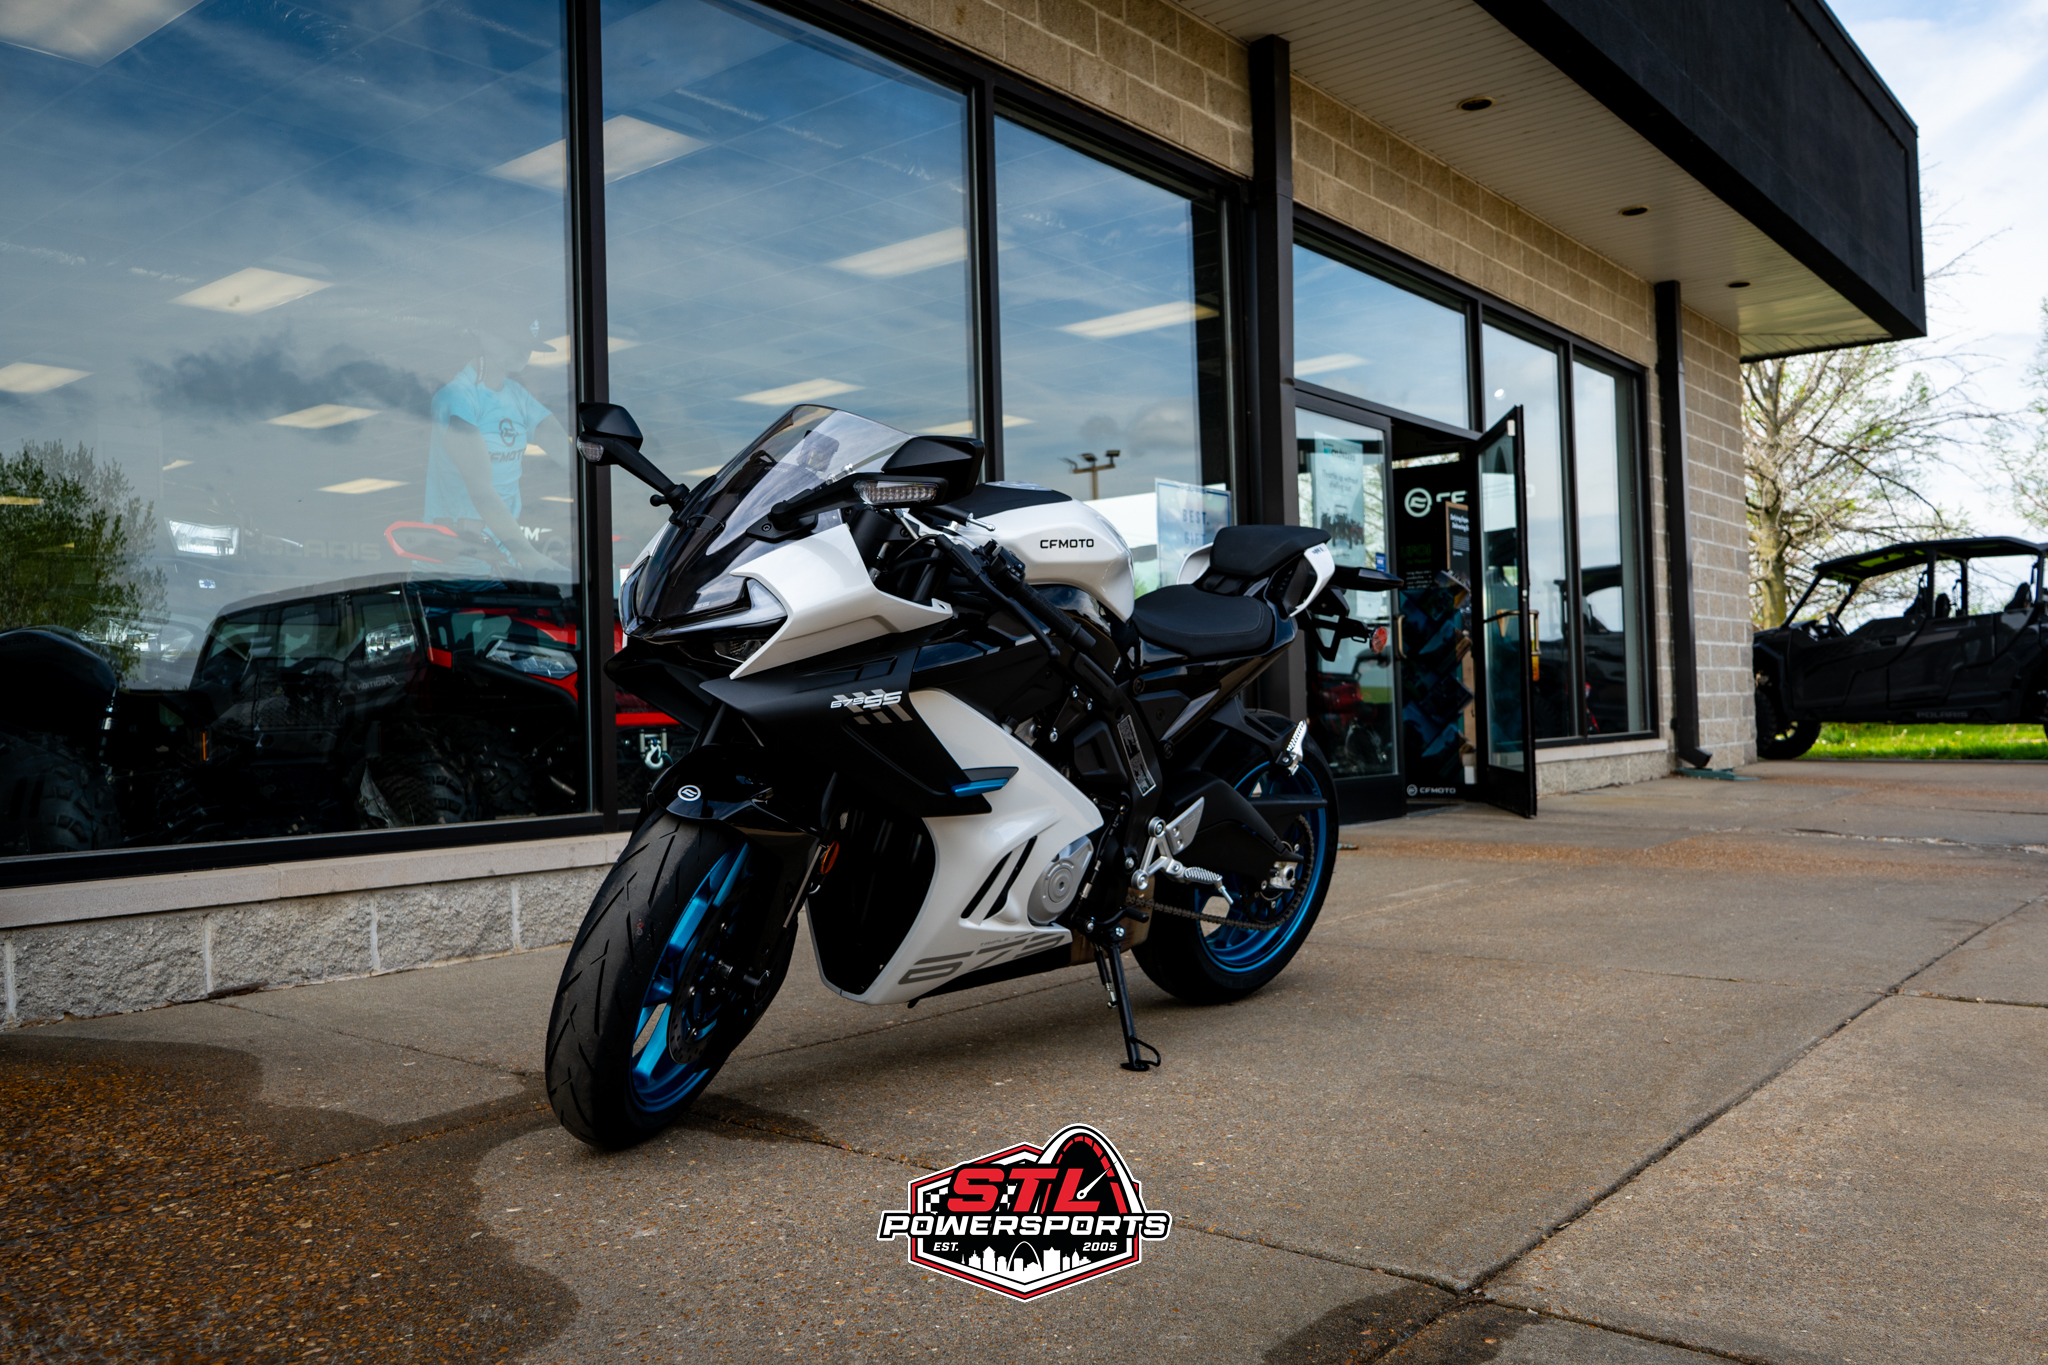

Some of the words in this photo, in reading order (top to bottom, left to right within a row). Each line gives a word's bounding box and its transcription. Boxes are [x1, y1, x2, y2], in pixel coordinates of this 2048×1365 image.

[489, 448, 526, 462] FMOT
[1040, 539, 1095, 549] CFMOTO
[1419, 786, 1457, 795] CFMOTO
[979, 936, 1011, 947] TRIPLE
